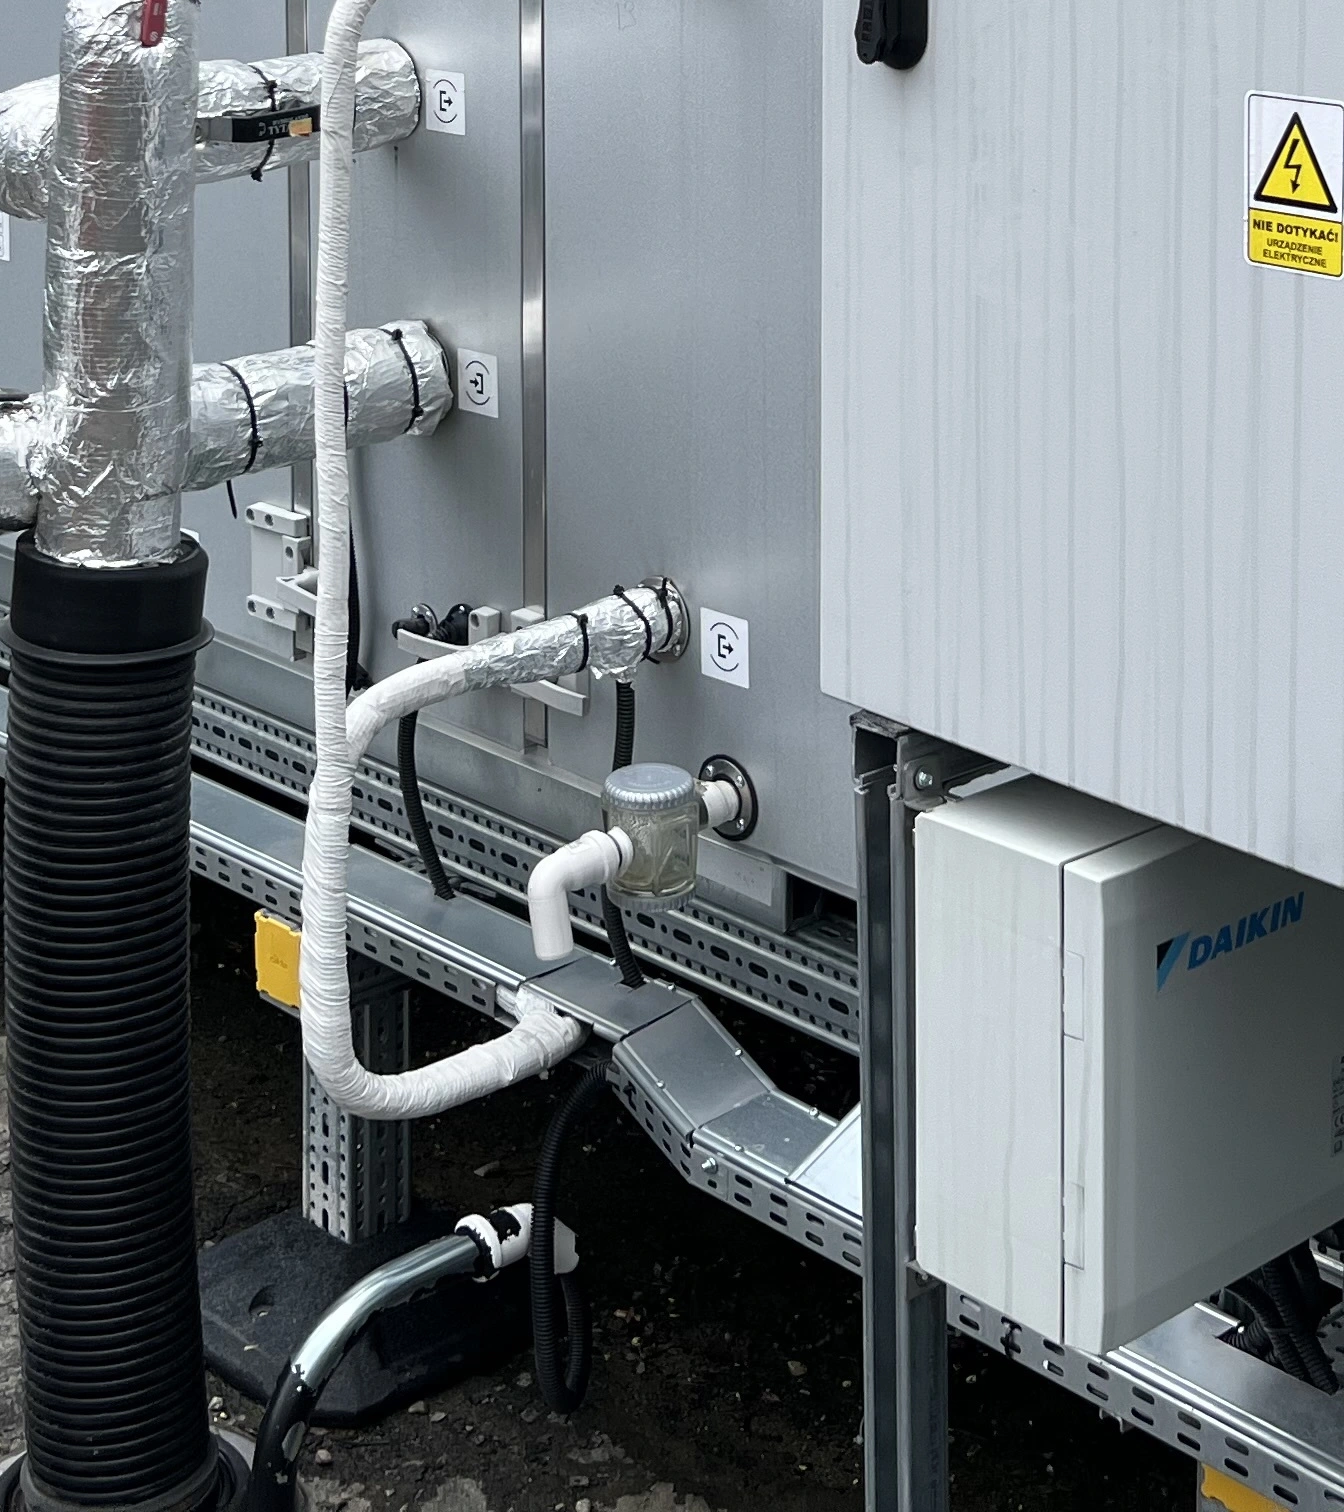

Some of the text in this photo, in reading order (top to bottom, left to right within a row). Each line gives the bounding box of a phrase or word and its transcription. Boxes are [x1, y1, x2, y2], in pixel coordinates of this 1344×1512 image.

[1253, 218, 1339, 243] NIE DOTYKAĆ!
[1267, 238, 1323, 256] URZĄDZENIE
[1263, 249, 1327, 269] ELEKTRYCZNE
[1187, 891, 1305, 971] DAIKIN
